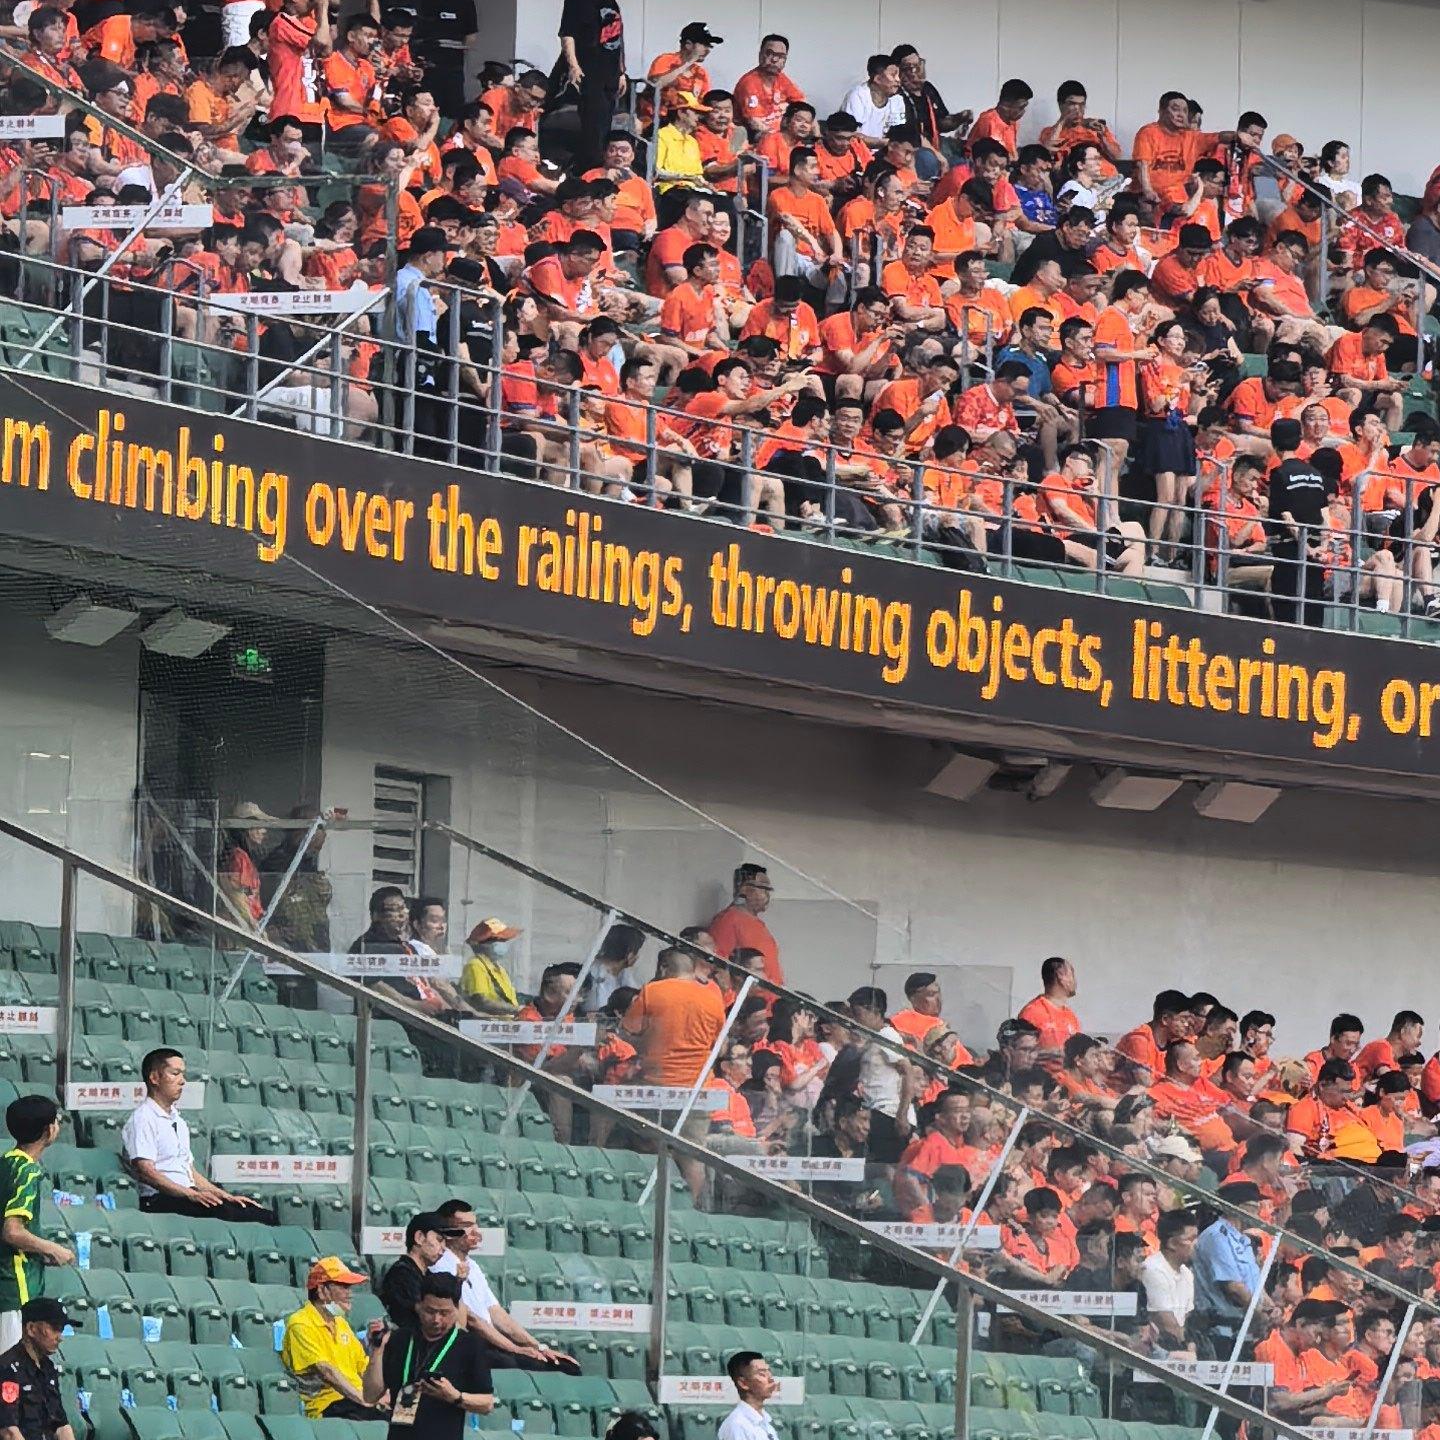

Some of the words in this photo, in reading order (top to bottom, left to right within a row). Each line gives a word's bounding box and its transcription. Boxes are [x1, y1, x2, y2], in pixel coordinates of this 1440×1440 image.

[66, 409, 288, 562] climbing
[304, 482, 413, 562] over
[427, 484, 502, 580] the
[517, 510, 692, 636] railings,
[709, 543, 911, 684] throwing
[925, 589, 1113, 707] objects,
[1131, 620, 1360, 748] littering,
[1380, 679, 1440, 737] or
